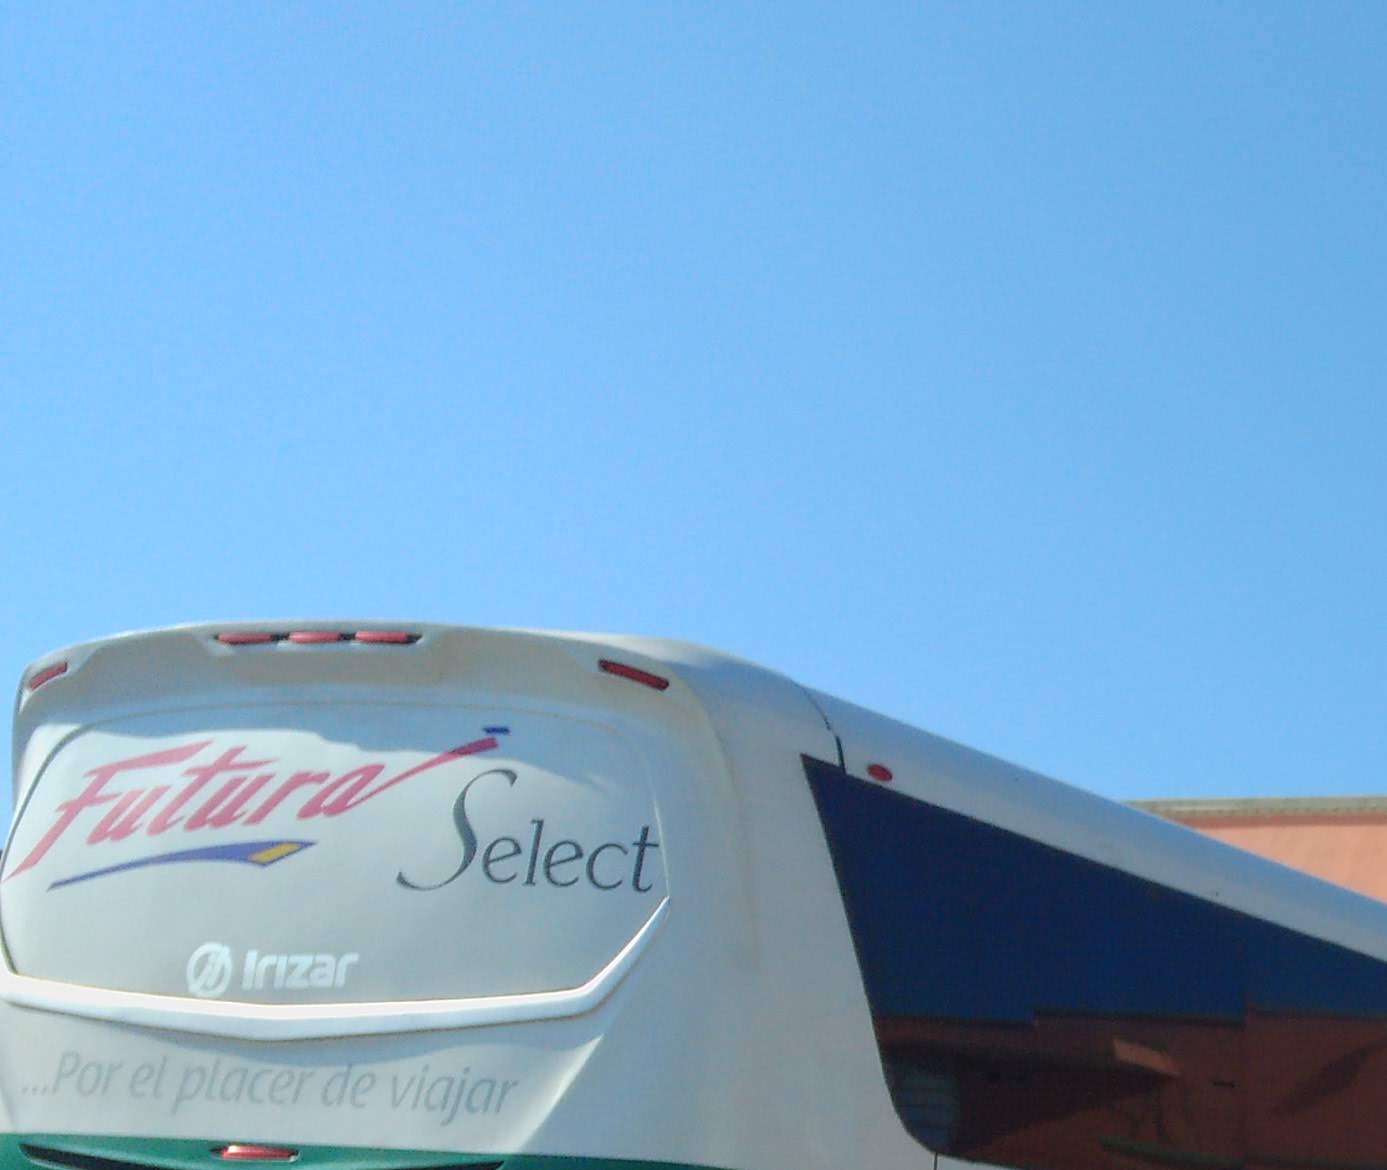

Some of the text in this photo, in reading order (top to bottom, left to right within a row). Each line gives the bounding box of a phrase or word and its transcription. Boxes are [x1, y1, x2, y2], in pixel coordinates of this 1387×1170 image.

[3, 737, 499, 880] Futura
[397, 769, 659, 892] Select
[129, 1056, 167, 1100] el
[172, 1058, 314, 1115] placer
[321, 1064, 376, 1109] de
[390, 1066, 518, 1126] viajar
